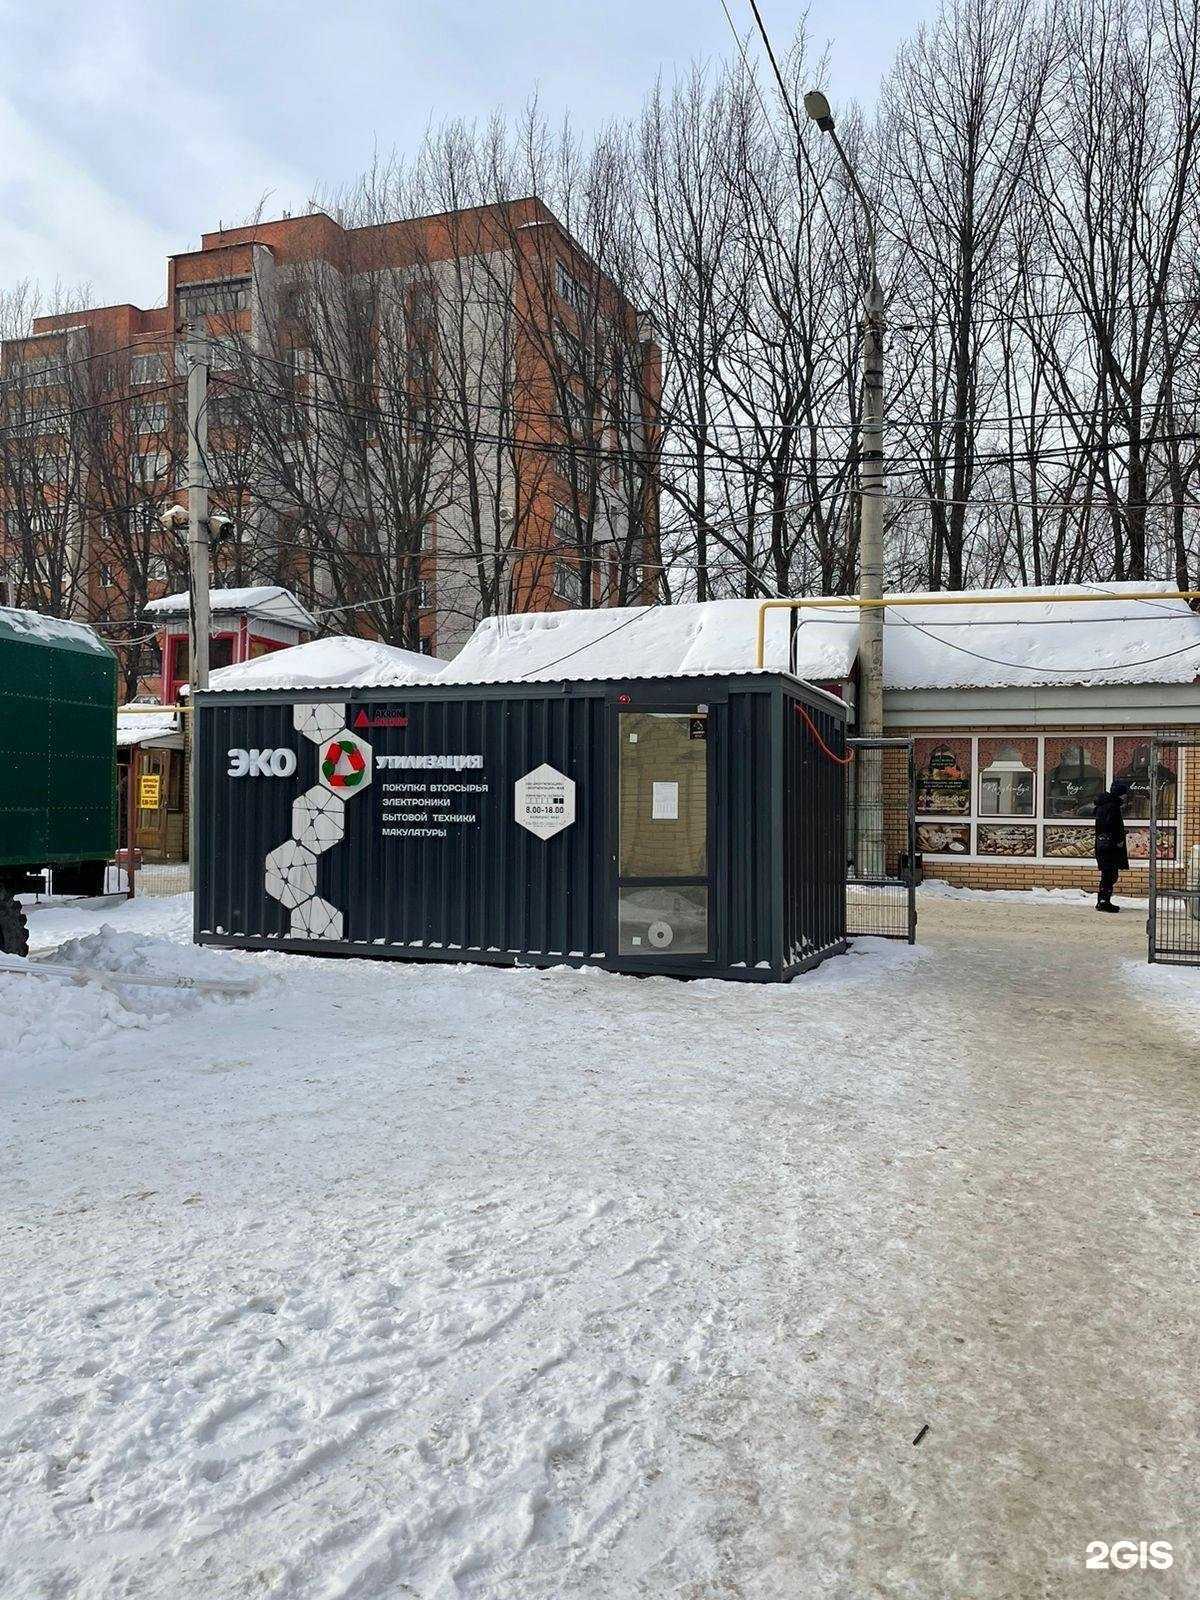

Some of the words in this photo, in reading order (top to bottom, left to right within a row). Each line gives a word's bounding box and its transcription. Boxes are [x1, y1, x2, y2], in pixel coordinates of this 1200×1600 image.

[227, 748, 297, 777] ЭКО
[375, 755, 484, 771] УТИЛИЗАЦИЯ
[382, 784, 427, 792] ПОКУПКА
[430, 784, 489, 792] ВТОРСЫРЬЯ
[382, 798, 451, 807] ЭЛЕКТРОНИКИ
[382, 812, 428, 822] БЫТОВОЙ
[433, 814, 476, 823] ТЕХНИКИ
[382, 828, 447, 837] МАКУЛАТУРЫ
